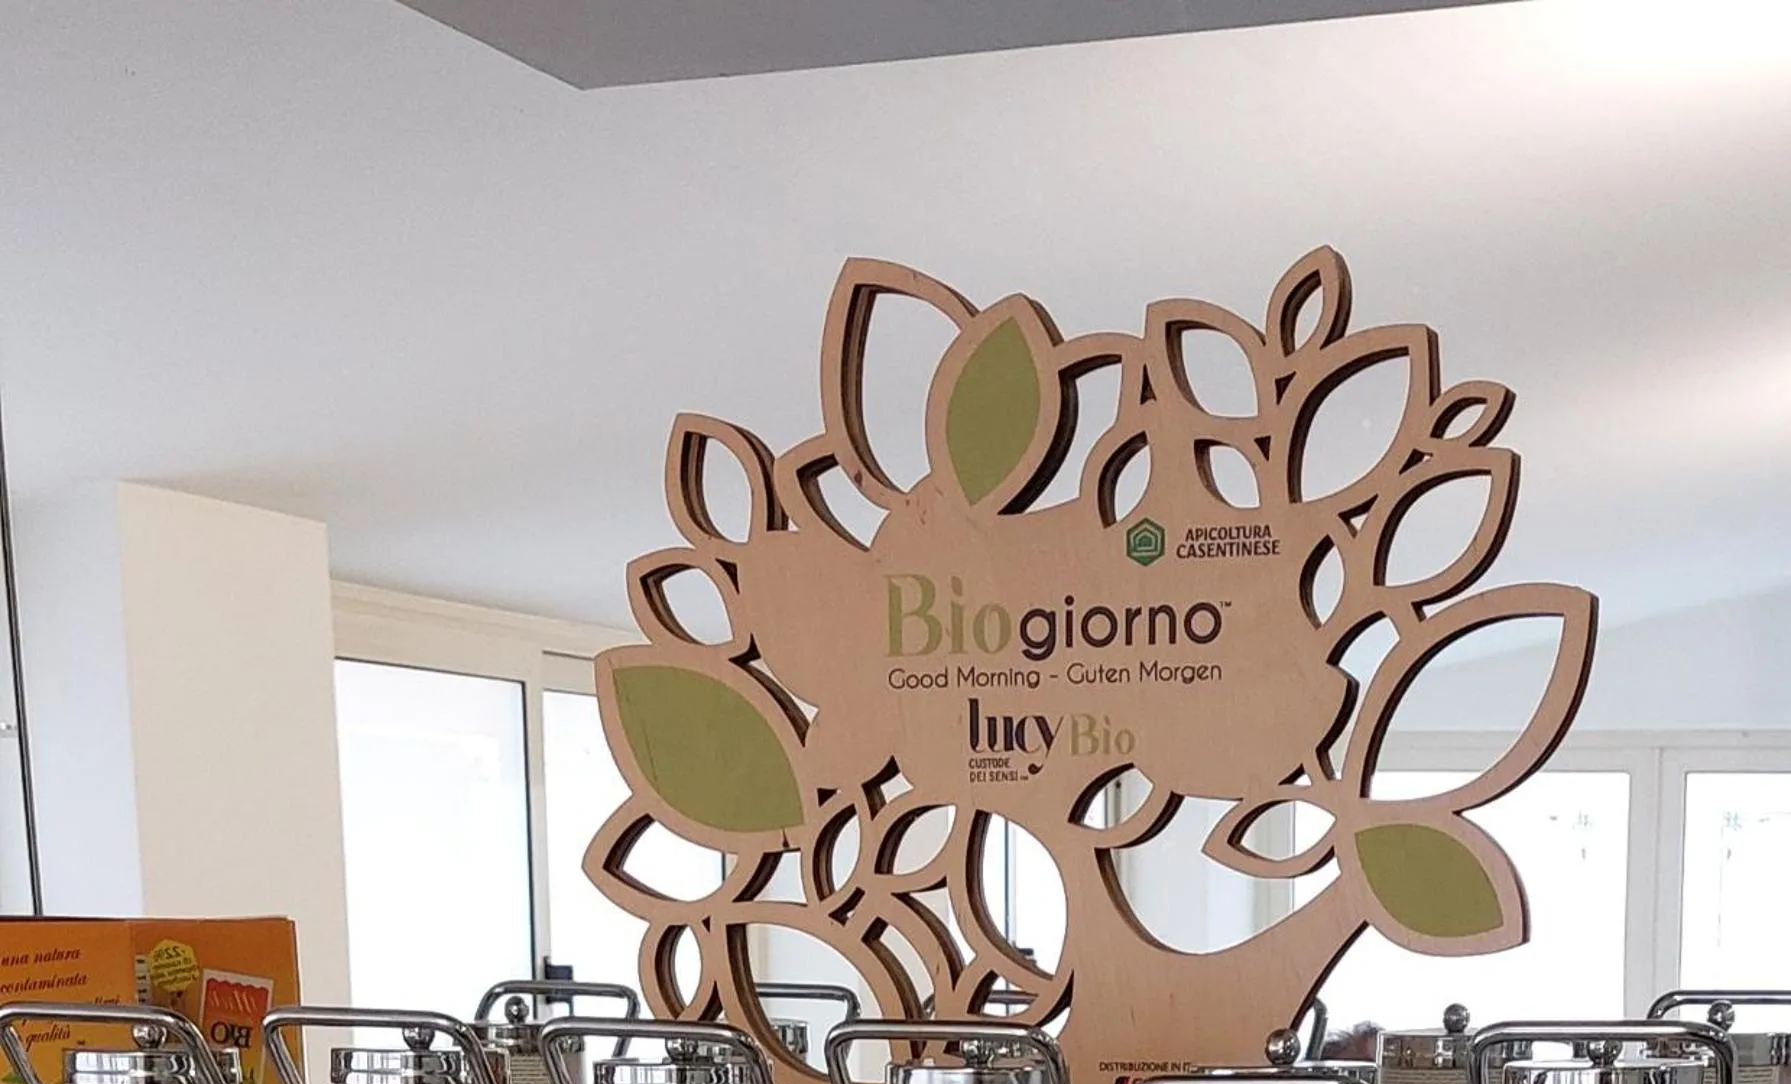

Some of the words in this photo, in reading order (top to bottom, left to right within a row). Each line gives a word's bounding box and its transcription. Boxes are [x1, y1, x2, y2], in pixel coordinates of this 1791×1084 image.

[1185, 524, 1272, 541] APICOLTURA
[1176, 539, 1281, 559] CASENTINESE
[888, 666, 949, 689] Good
[957, 665, 1041, 689] Morning
[1066, 662, 1131, 685] Guten
[1139, 660, 1223, 684] Morgen
[969, 771, 987, 783] DEI
[1099, 1061, 1169, 1073] DISTRIBUZIONE
